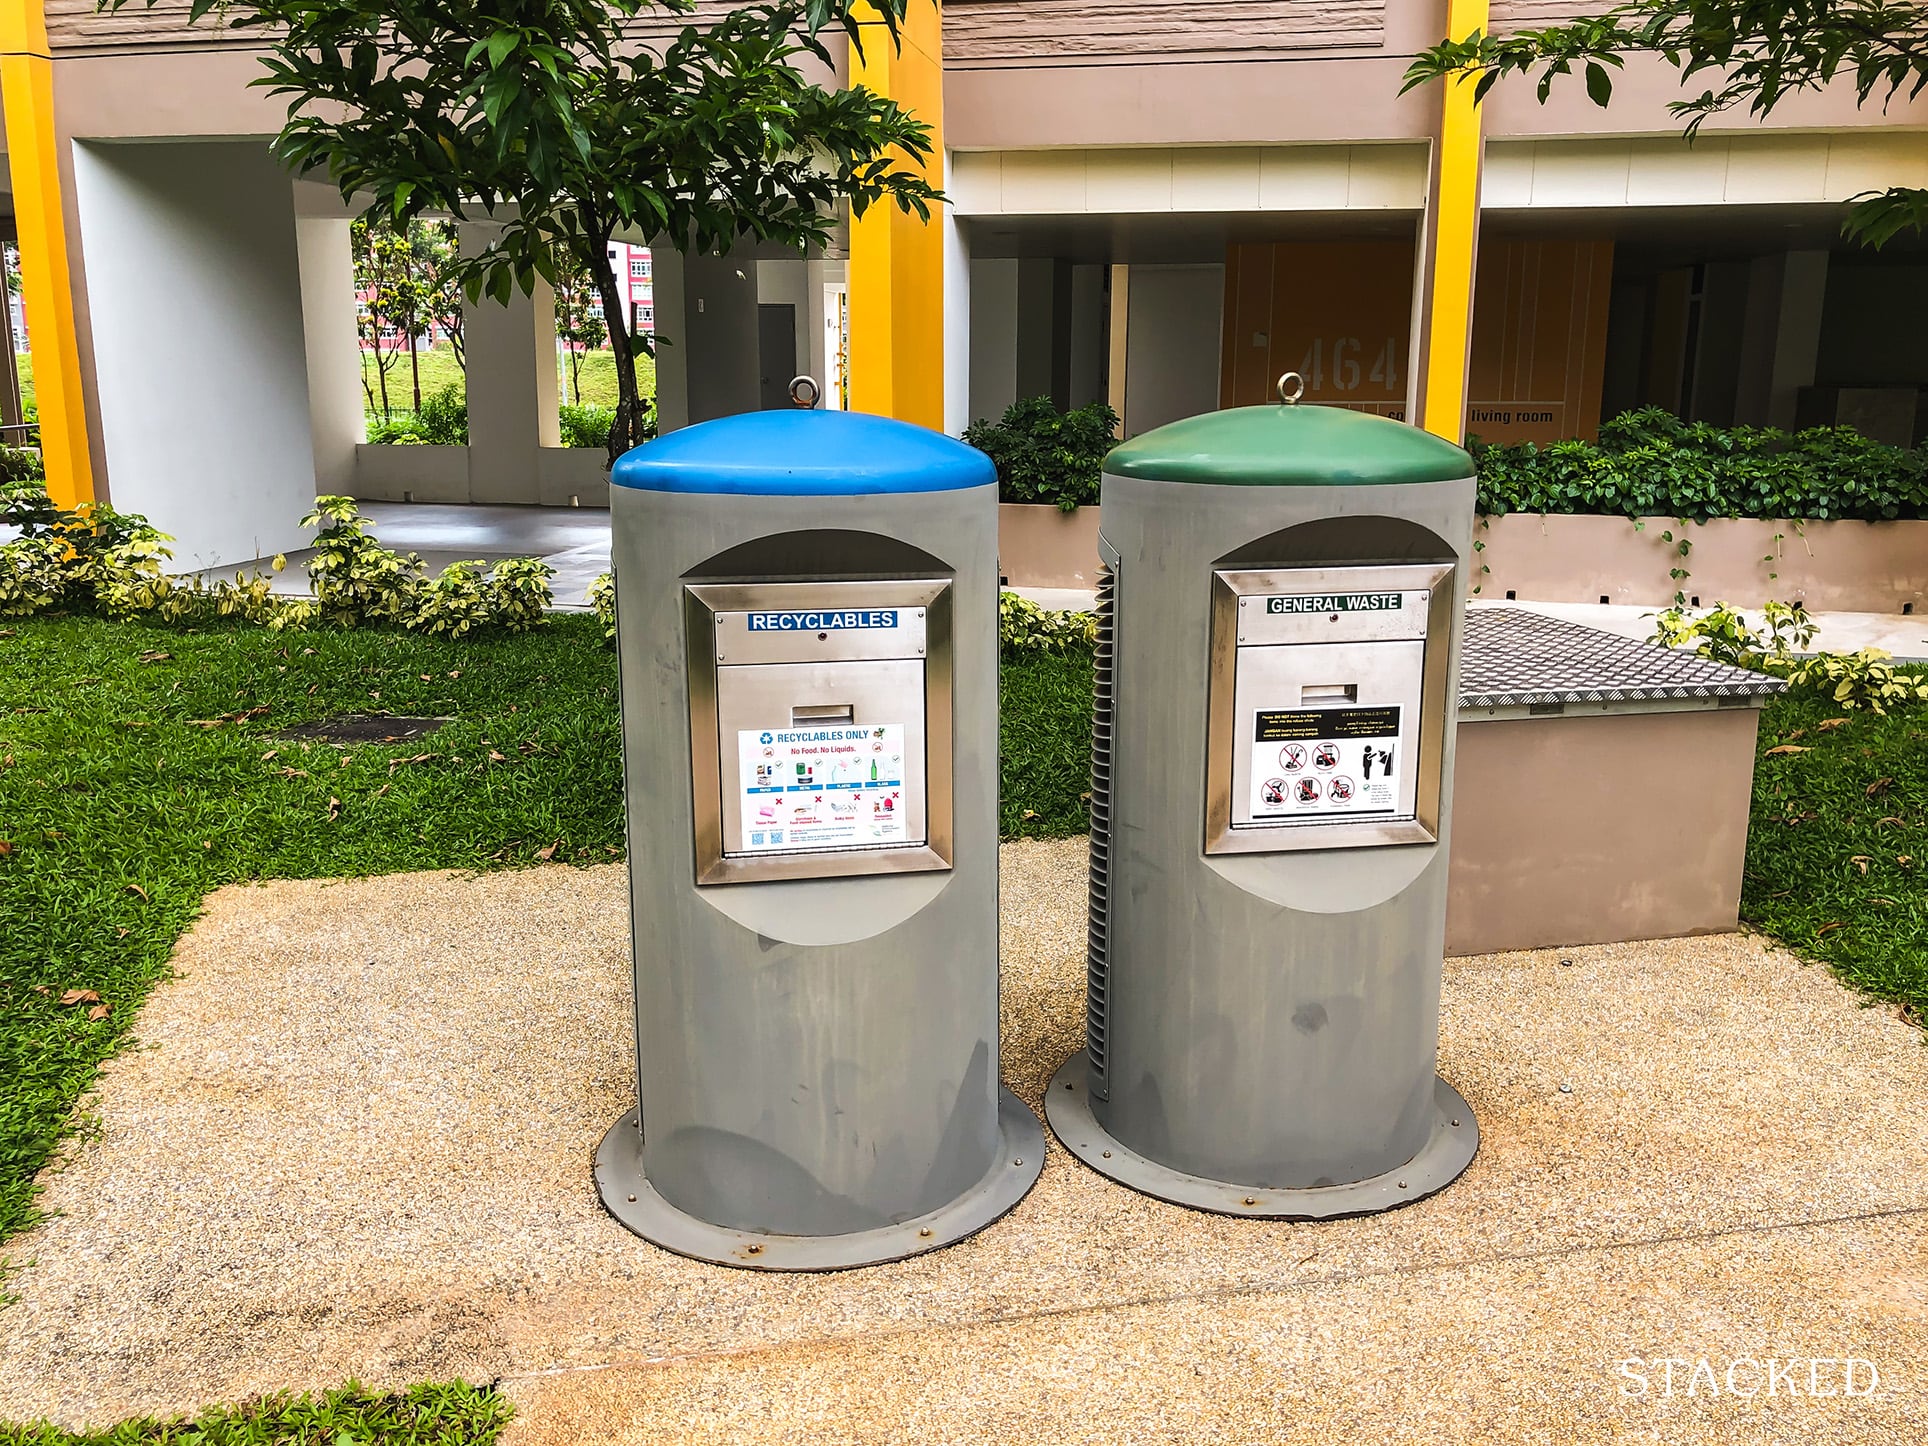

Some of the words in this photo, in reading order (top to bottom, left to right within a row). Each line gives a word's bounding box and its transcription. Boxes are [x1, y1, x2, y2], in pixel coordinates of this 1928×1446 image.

[1299, 337, 1397, 391] 464
[1471, 409, 1511, 424] living
[1516, 412, 1553, 422] room
[1271, 597, 1343, 613] GENERAL
[1346, 594, 1398, 610] WASTE
[752, 612, 893, 630] RECYCLABLES
[777, 731, 843, 743] RECYCLABLES
[845, 730, 869, 740] ONLY
[830, 745, 857, 754] Liquids.
